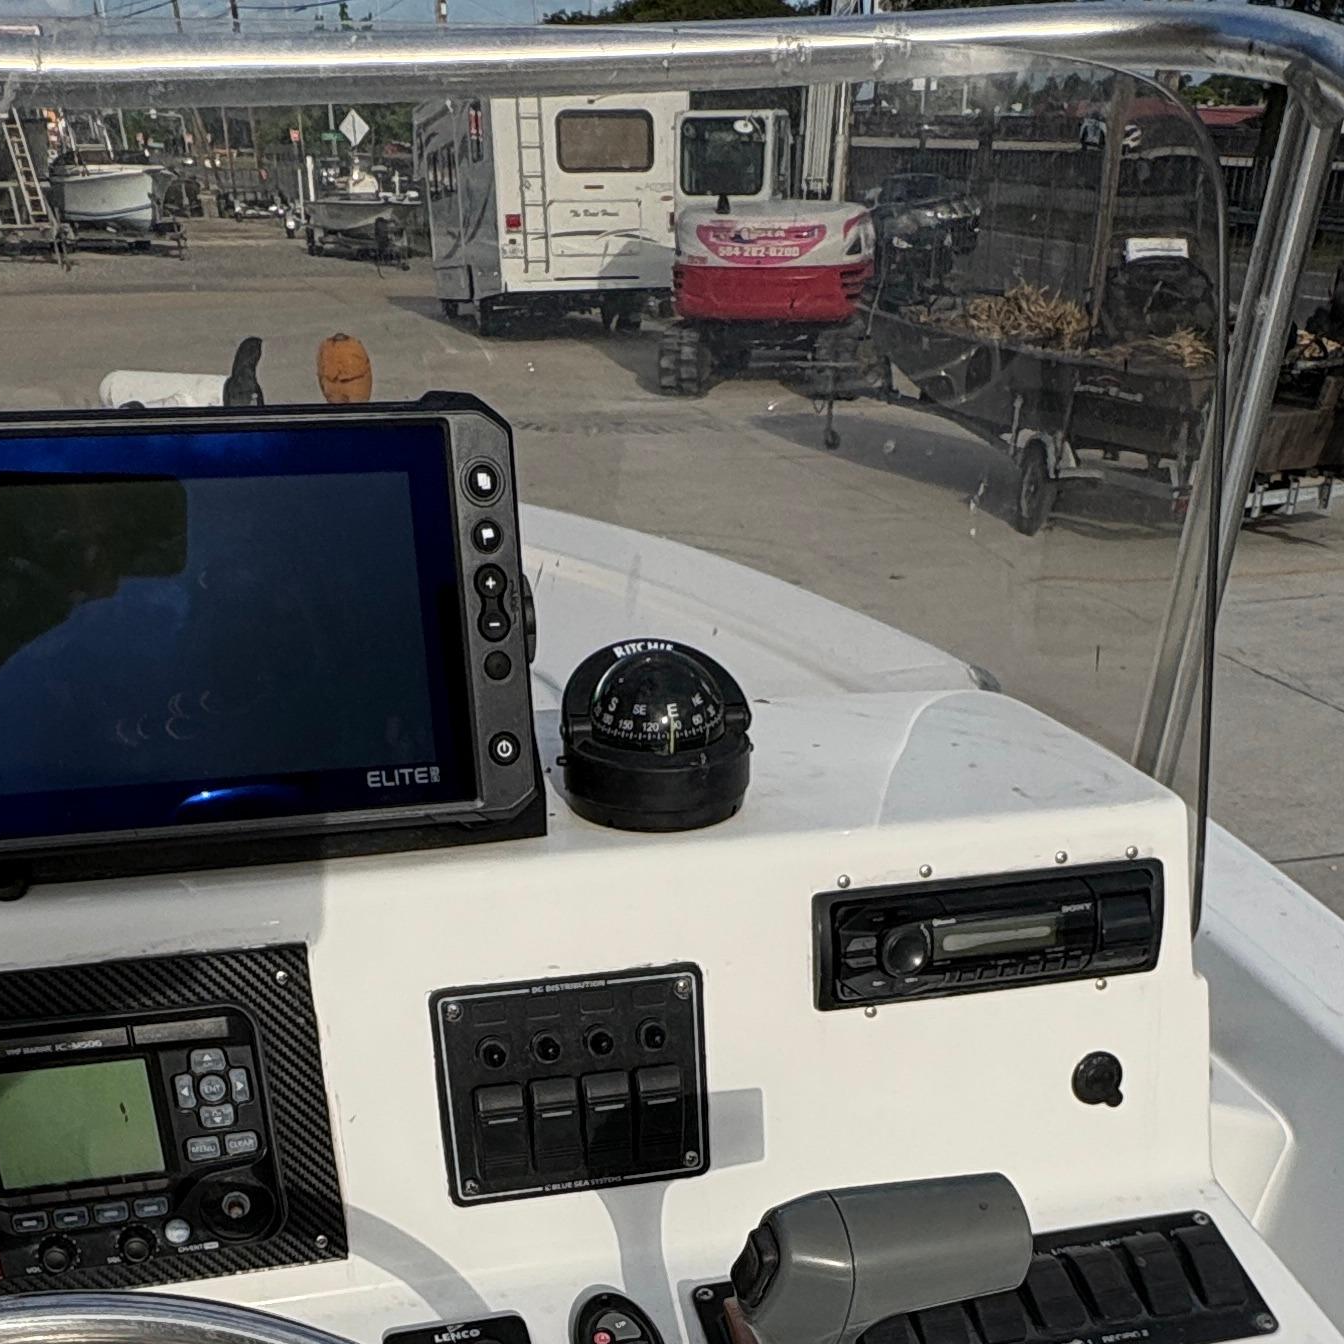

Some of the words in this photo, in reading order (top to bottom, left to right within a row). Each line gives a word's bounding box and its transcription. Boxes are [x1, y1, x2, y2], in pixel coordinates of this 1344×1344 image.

[632, 704, 647, 716] SE
[666, 703, 680, 717] E
[642, 721, 659, 732] 120
[366, 766, 429, 788] ELITE
[434, 1328, 480, 1344] LENCO
